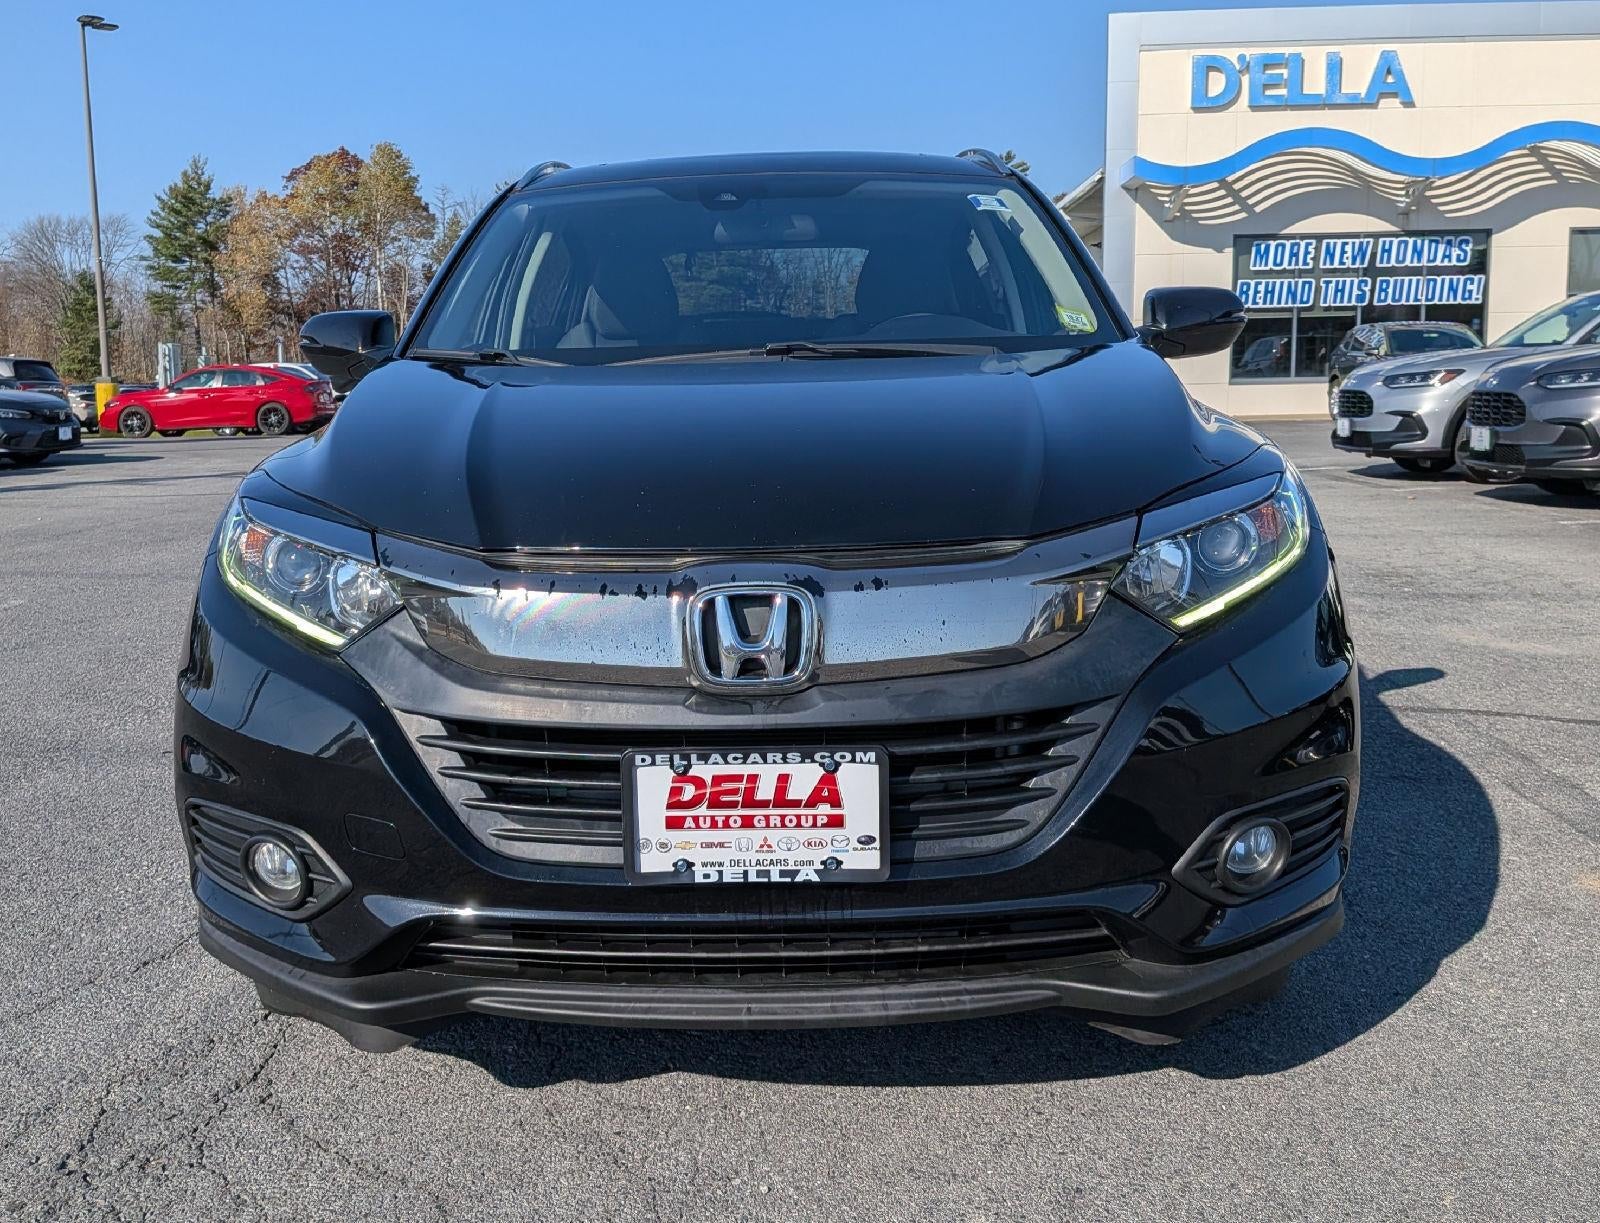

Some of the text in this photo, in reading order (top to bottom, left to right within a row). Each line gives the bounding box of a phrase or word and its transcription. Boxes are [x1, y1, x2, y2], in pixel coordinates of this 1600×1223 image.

[1191, 50, 1415, 109] D'ELLA
[1250, 236, 1472, 270] MORE NEW HONDAS
[1238, 275, 1485, 308] BEHIND THIS BUILDING!
[634, 752, 876, 766] DELLACARS.COM
[665, 773, 844, 811] DELLA
[683, 815, 829, 829] AUTO GROUP
[700, 841, 732, 849] GMC
[807, 840, 824, 848] KIA
[700, 858, 815, 868] www.DELLACARS.com
[694, 869, 821, 883] DELLA
